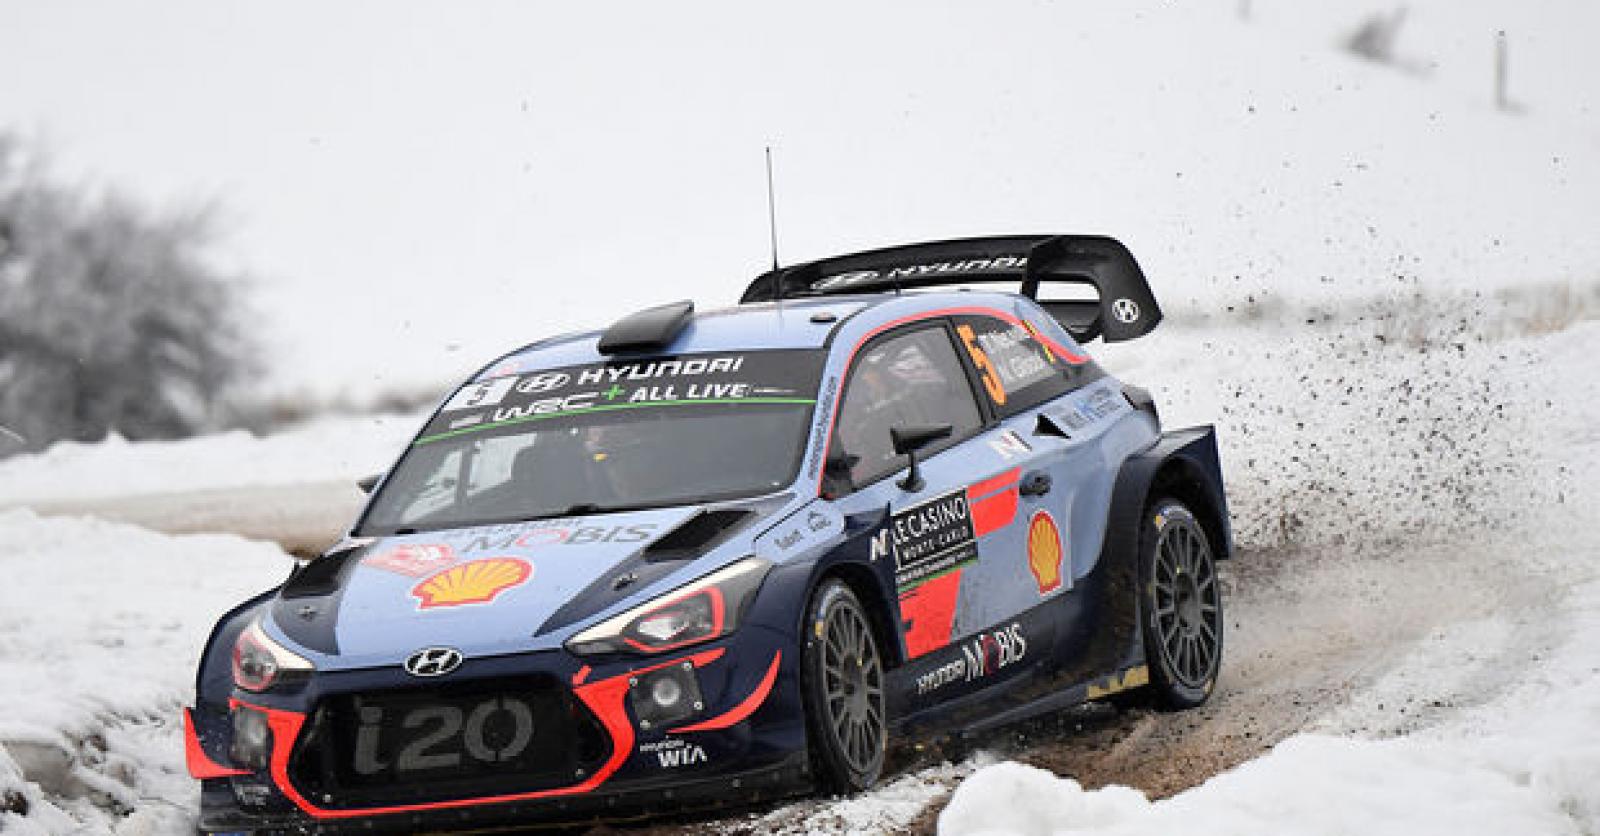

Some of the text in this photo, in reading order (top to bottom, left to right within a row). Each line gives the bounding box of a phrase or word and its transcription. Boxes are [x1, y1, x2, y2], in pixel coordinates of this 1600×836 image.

[577, 355, 744, 387] HYUNDAI
[957, 323, 1007, 406] 5
[628, 386, 680, 403] ALL
[686, 383, 749, 399] LIVE
[907, 497, 967, 538] CASINO
[461, 522, 659, 553] MOBIS
[961, 622, 1026, 682] MOBIS
[354, 697, 532, 774] i20
[657, 743, 708, 768] WIA
